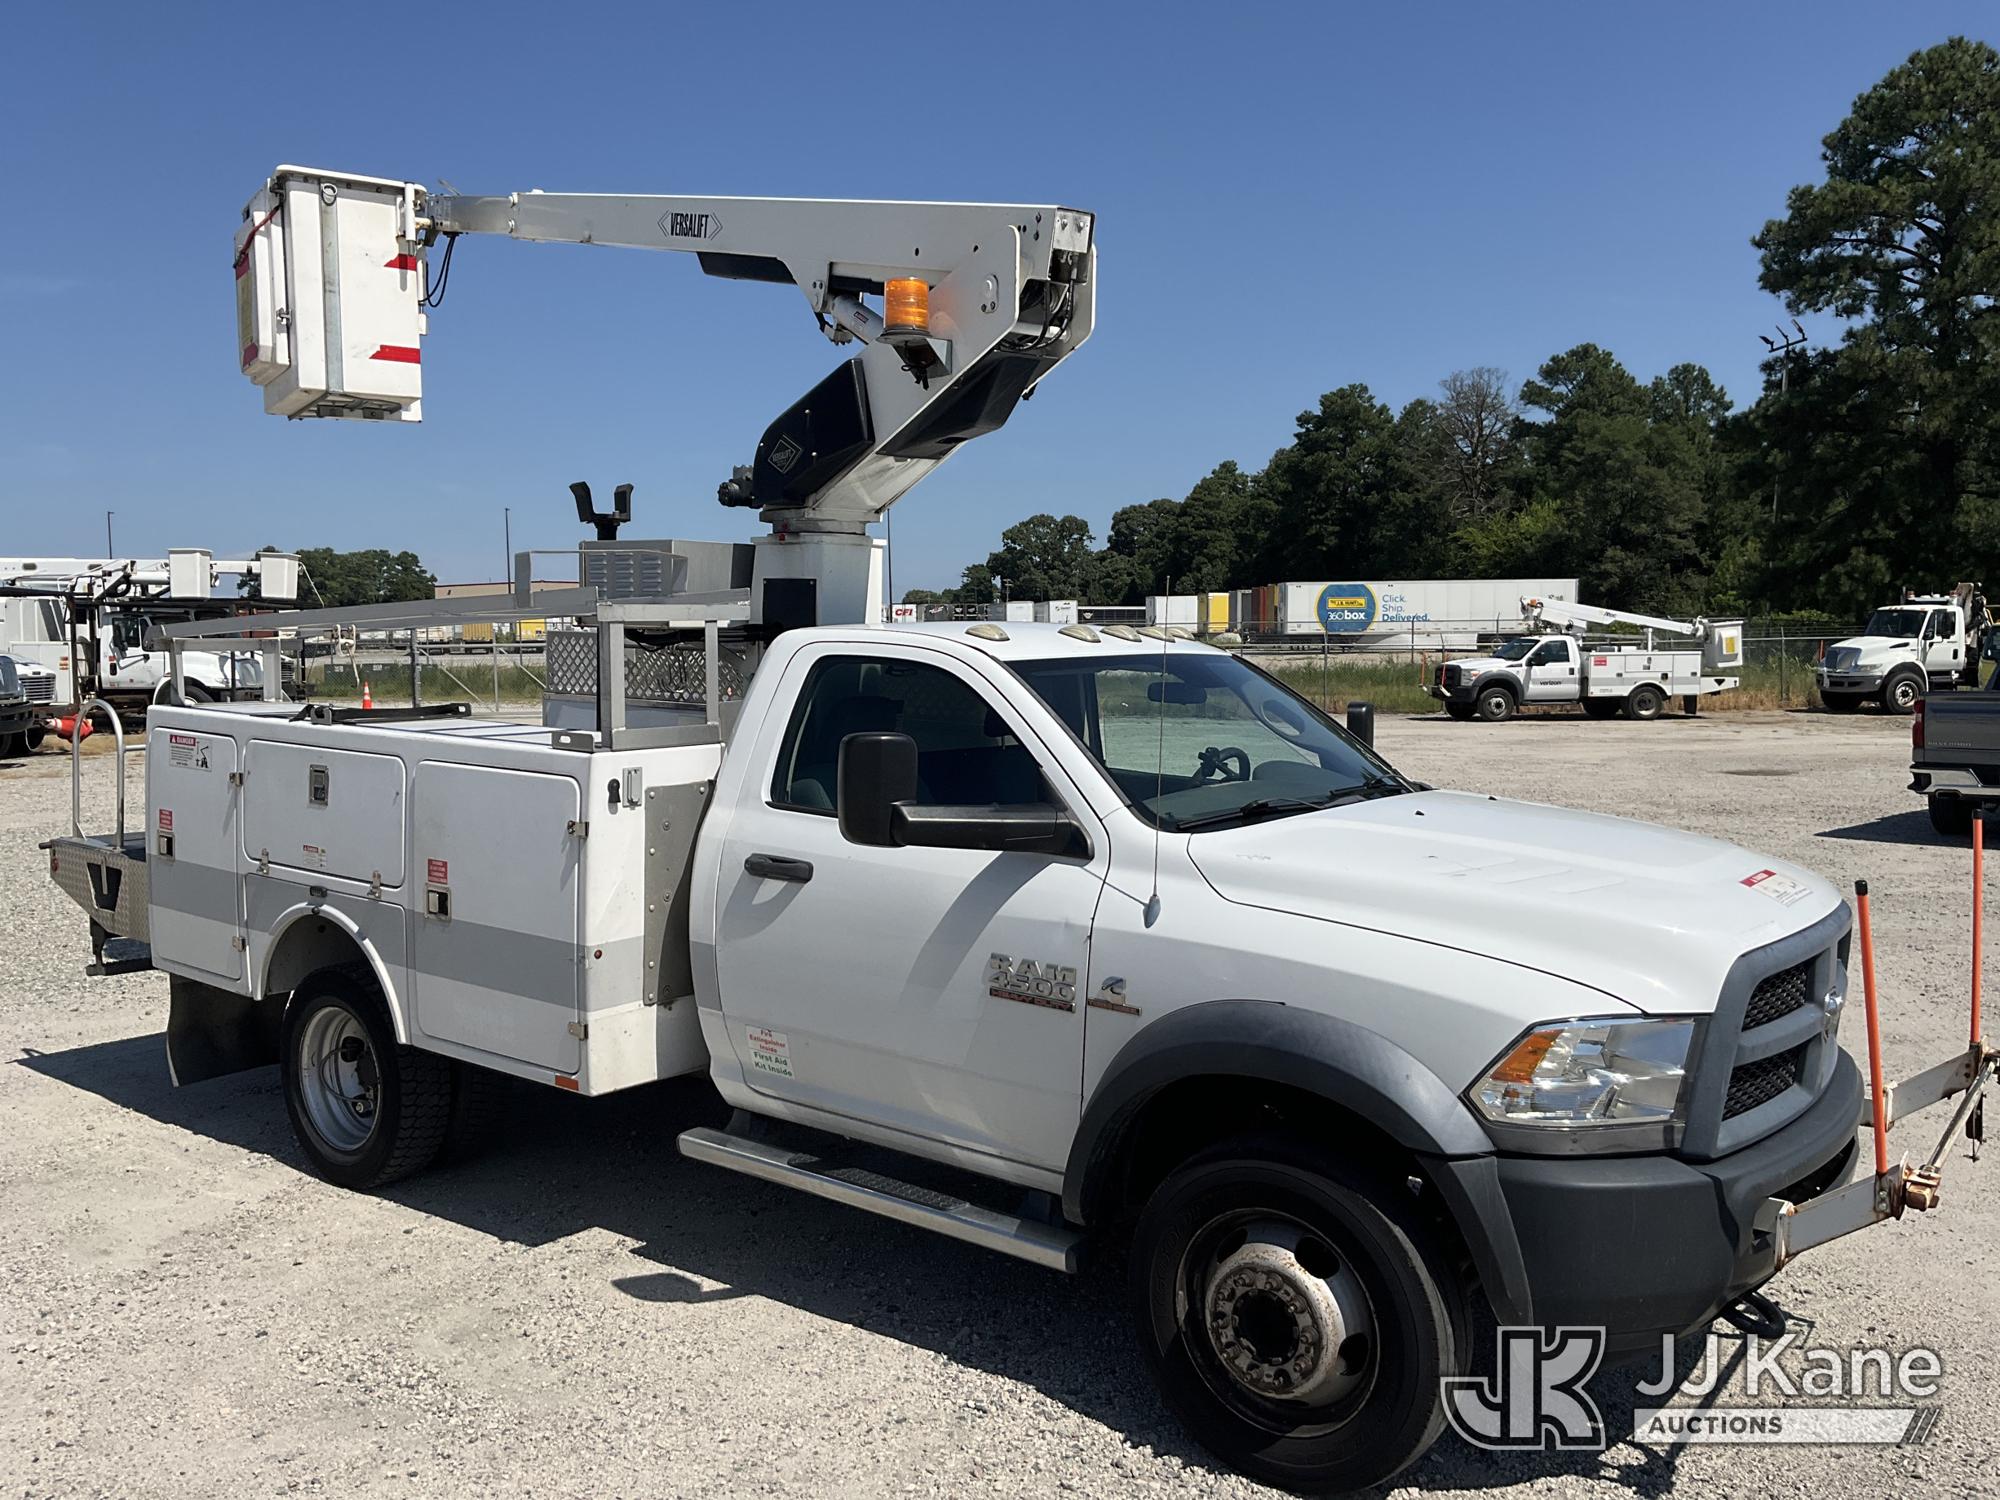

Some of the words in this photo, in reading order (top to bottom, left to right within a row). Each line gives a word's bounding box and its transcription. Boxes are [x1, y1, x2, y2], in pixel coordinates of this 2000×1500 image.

[671, 213, 709, 238] VERSALIFT
[895, 608, 913, 617] CFI
[990, 952, 1077, 986] RAM
[988, 971, 1076, 1002] 4500
[753, 1051, 772, 1063] First
[774, 1057, 788, 1066] Aid
[754, 1061, 767, 1070] Kit
[768, 1065, 793, 1077] Inside
